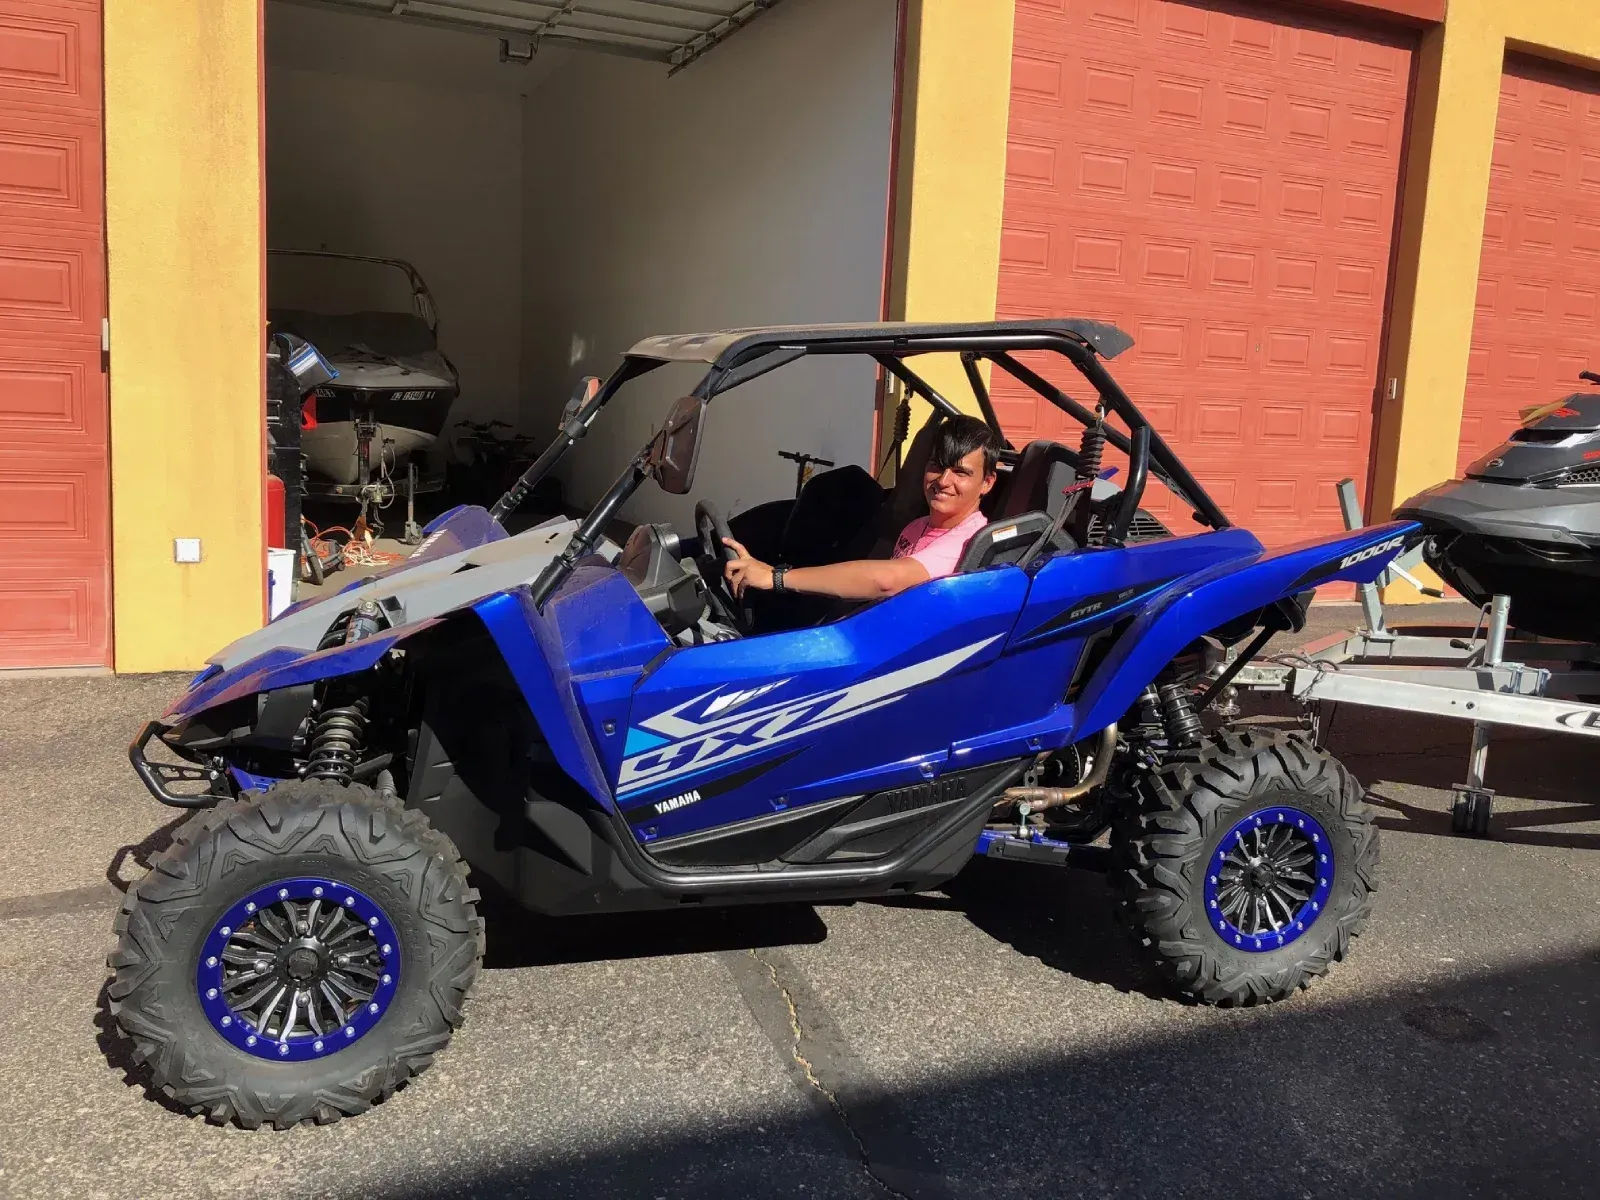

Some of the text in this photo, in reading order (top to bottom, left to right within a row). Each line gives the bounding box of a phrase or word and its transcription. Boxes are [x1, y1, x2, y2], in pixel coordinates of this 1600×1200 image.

[1339, 535, 1405, 569] 1000R
[1069, 601, 1103, 619] GYTR
[653, 789, 701, 814] YAMAHA
[887, 776, 965, 813] YAMAHA
